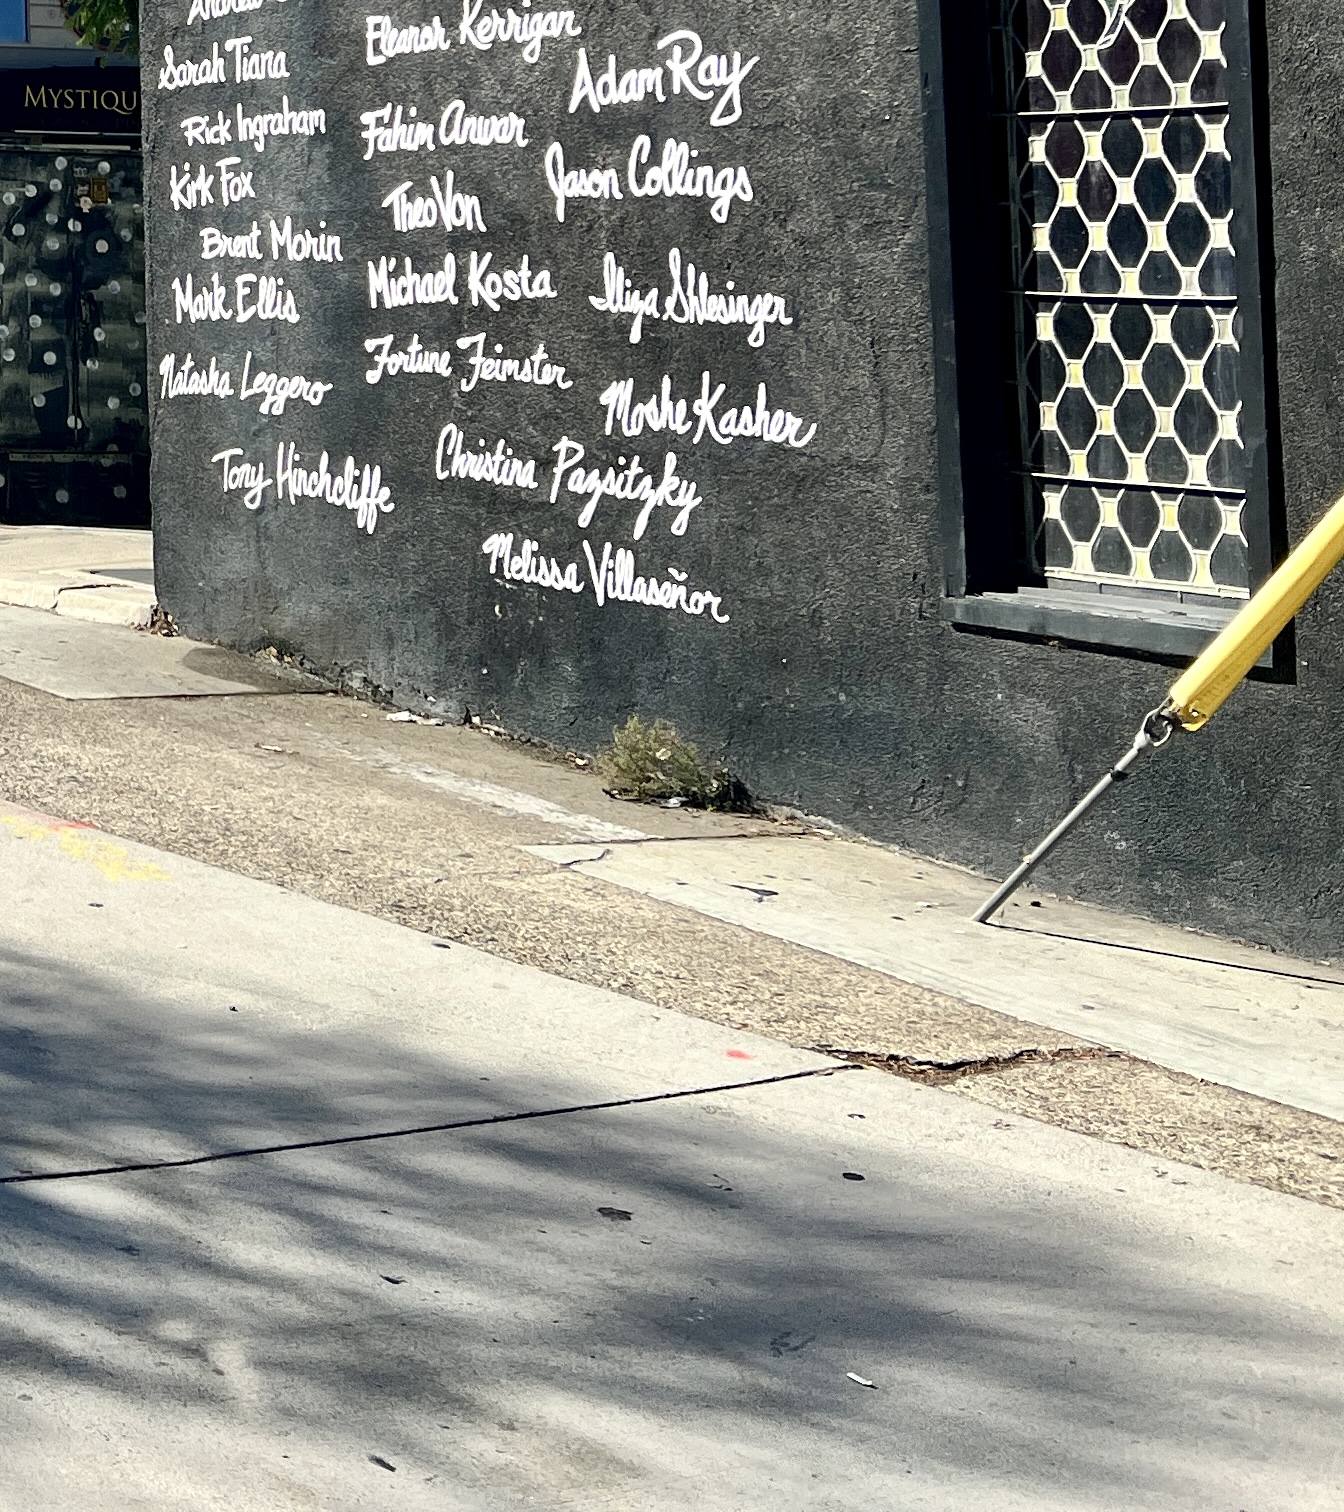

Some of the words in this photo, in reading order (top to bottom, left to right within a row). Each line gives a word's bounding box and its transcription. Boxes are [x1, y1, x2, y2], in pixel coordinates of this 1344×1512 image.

[158, 42, 226, 90] Sarah
[225, 35, 291, 83] Tiana
[365, 15, 451, 66] Eleanor
[24, 84, 137, 115] MYSTIQU
[568, 47, 666, 114] Adam
[657, 30, 761, 127] Ray
[180, 110, 232, 147] Rick
[236, 95, 326, 152] Ingraham
[360, 101, 436, 161] Fahim
[439, 99, 529, 148] Anwar
[170, 162, 215, 211] Kirk
[215, 156, 256, 207] Fox
[381, 180, 438, 232] Theo
[430, 169, 487, 232] Von
[545, 141, 623, 223] Jason
[628, 134, 754, 224] Collings
[199, 221, 263, 260] Brent
[270, 215, 344, 262] Morin
[171, 272, 233, 324] Mark
[235, 272, 301, 324] Ellis
[368, 251, 459, 310] Michael
[468, 251, 558, 312] Kosta
[662, 247, 794, 348] Shlesinger
[159, 352, 234, 400] Natasha
[240, 349, 334, 416] Leggero
[364, 333, 453, 385] Fortune
[456, 332, 574, 392] Feimster
[599, 374, 692, 437] Moshe
[692, 370, 818, 448] Kasher
[435, 423, 539, 489] Christina
[211, 447, 273, 510] Tony
[276, 441, 395, 535] Hinchcliffe
[482, 533, 585, 593] Melissa
[583, 540, 730, 623] Villaseñor
